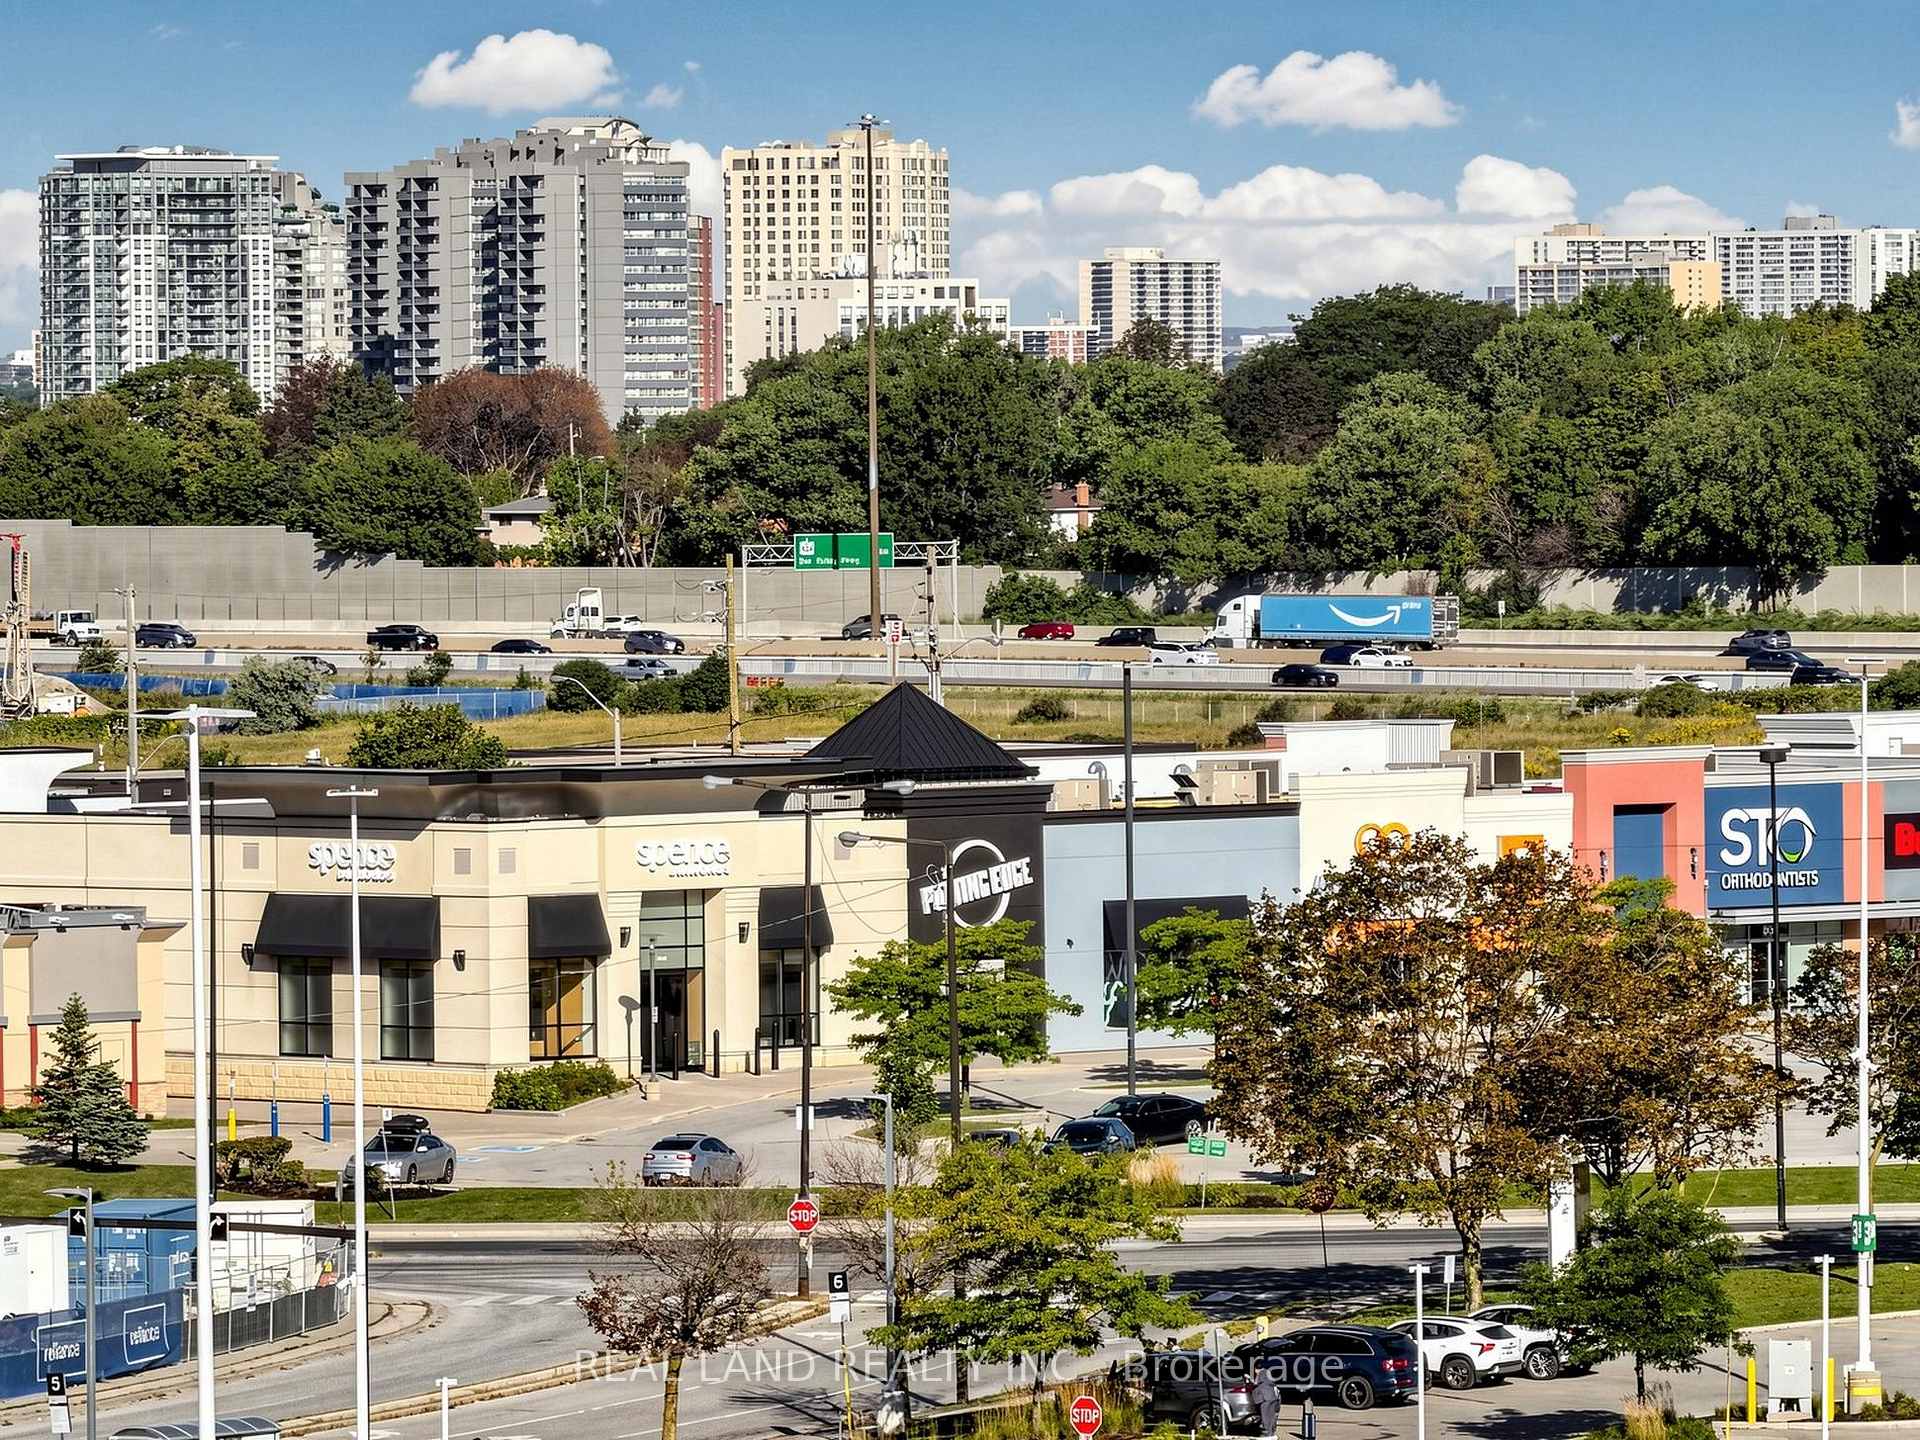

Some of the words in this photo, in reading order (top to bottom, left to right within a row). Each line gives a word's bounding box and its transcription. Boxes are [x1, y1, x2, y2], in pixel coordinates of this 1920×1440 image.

[1720, 806, 1817, 866] STO
[307, 841, 397, 877] spence
[637, 841, 731, 873] spence
[790, 1209, 818, 1222] STOP
[833, 1275, 843, 1289] 6
[50, 1376, 61, 1392] 5
[1072, 1407, 1100, 1424] STOP
